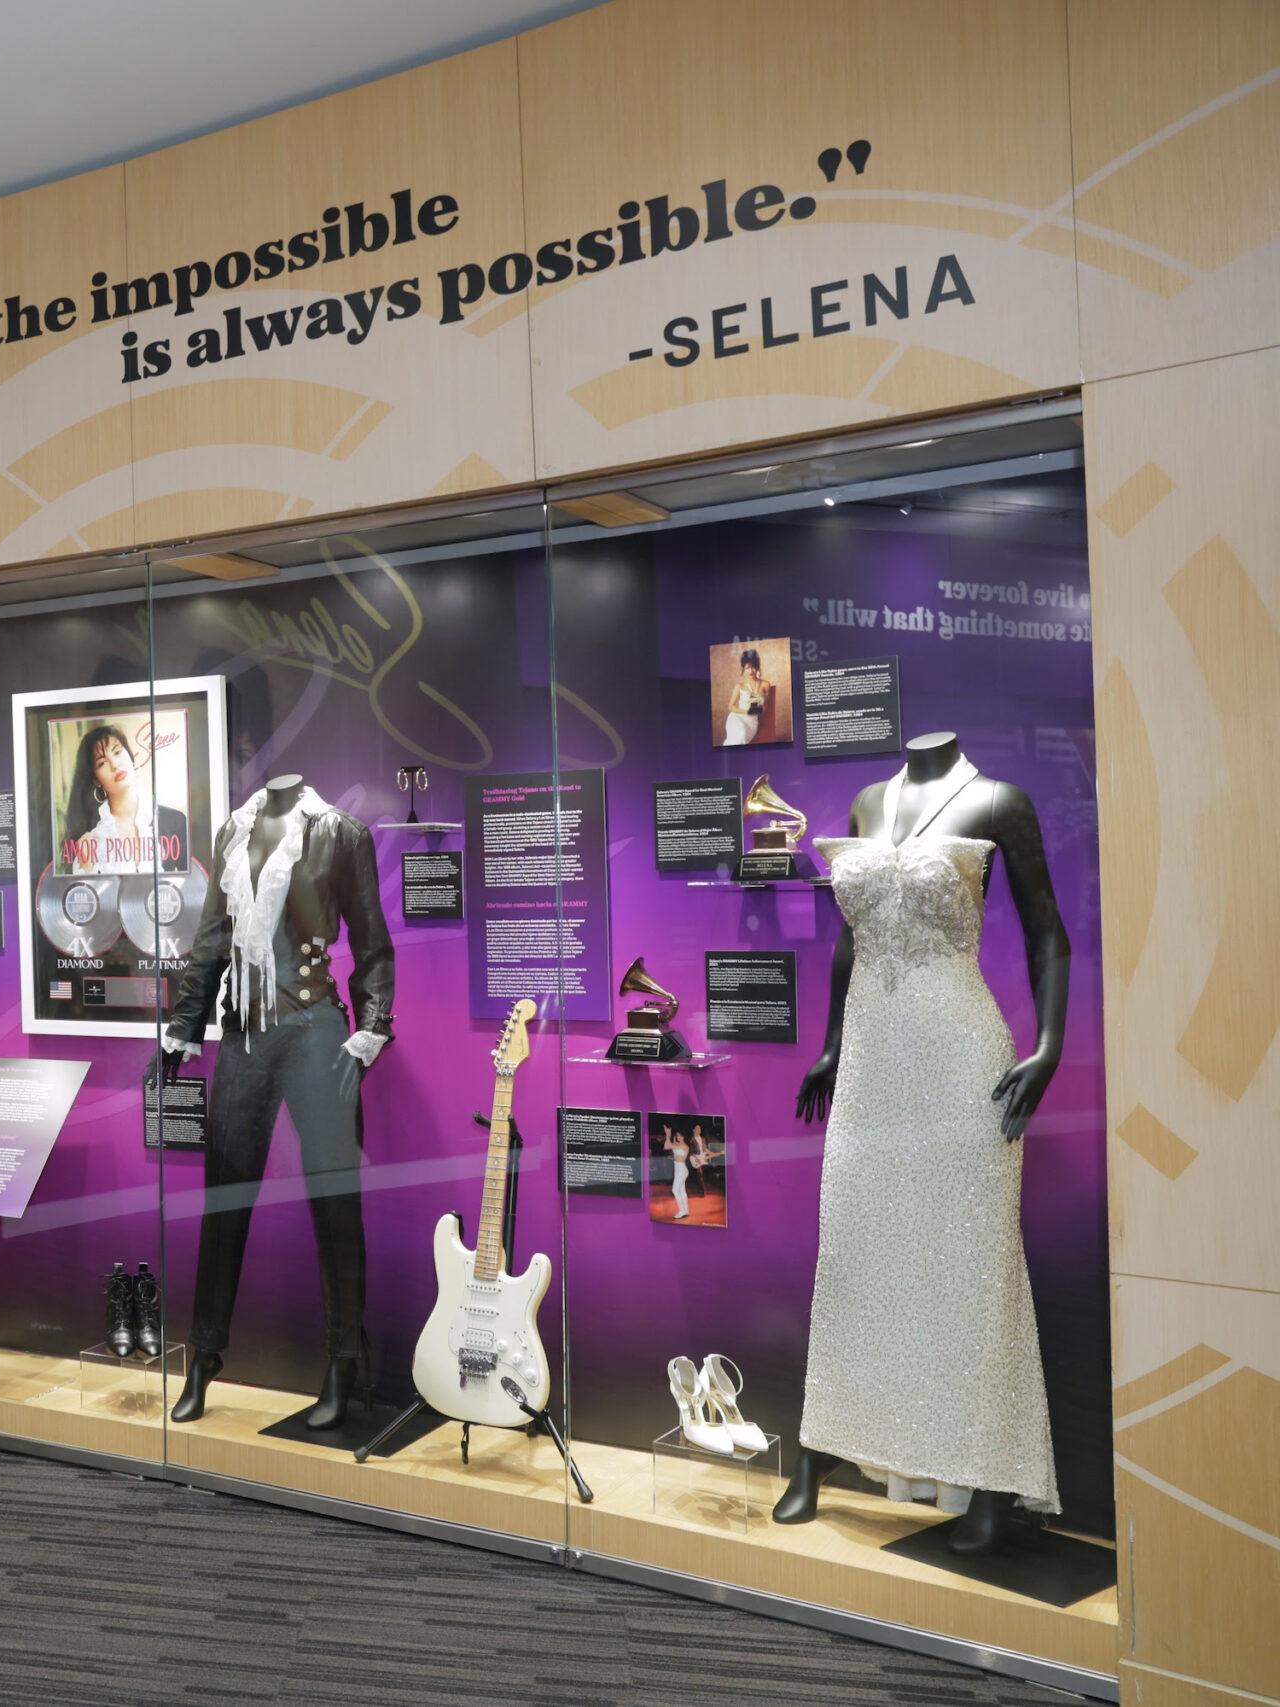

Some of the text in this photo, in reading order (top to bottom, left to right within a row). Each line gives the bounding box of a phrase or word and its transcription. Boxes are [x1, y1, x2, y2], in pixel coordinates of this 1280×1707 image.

[90, 188, 460, 324] impossible
[628, 253, 976, 368] -SELENA
[120, 332, 173, 383] is
[186, 272, 422, 372] always
[62, 834, 180, 865] AMOR PROHIBDO
[57, 958, 104, 969] DIAMOND
